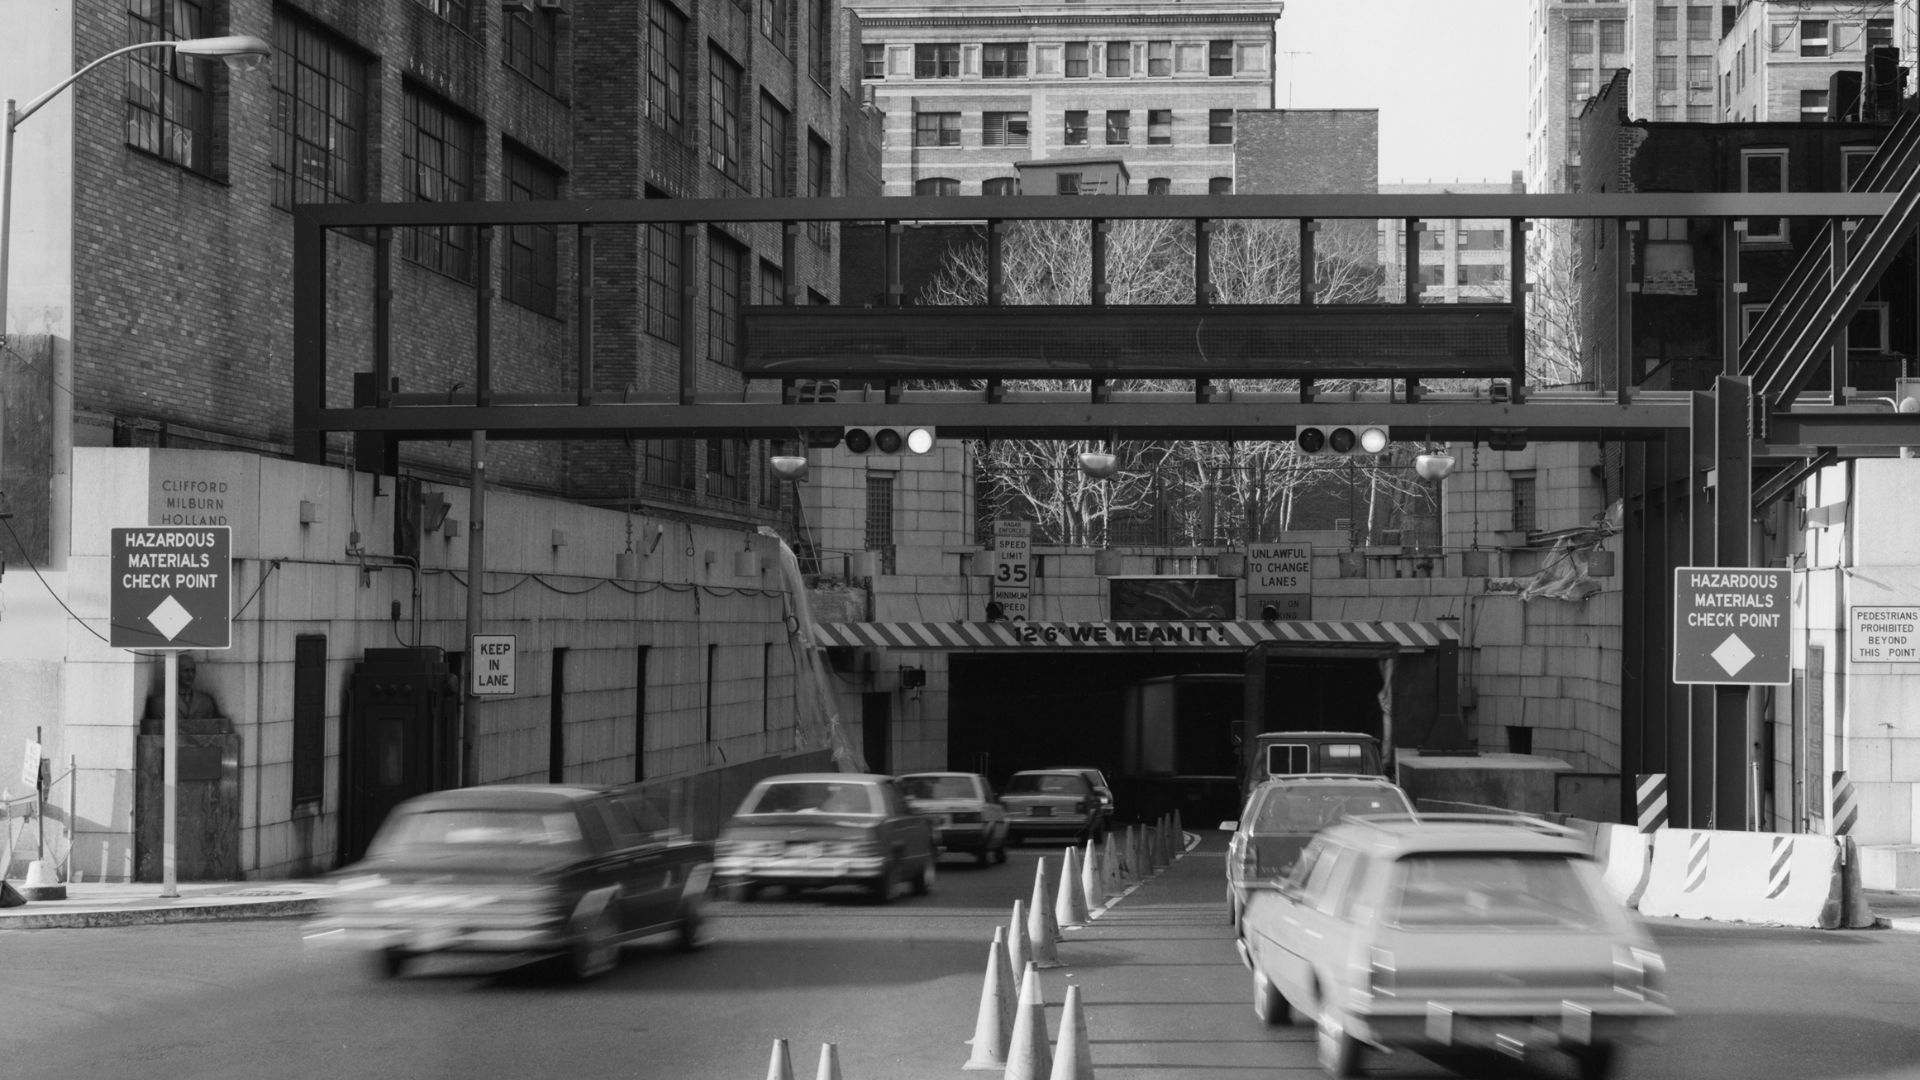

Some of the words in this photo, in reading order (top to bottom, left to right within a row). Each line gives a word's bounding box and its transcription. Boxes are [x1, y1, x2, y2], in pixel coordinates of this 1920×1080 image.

[162, 480, 228, 493] CLIFFORD
[167, 498, 224, 509] MILBURN
[162, 514, 227, 526] HOLLAND
[125, 533, 215, 547] HAZARDOUS
[1252, 549, 1307, 559] UNLAWFUL
[128, 554, 210, 568] MATERIALS
[1250, 563, 1262, 572] TO
[1267, 562, 1309, 572] CHANGE
[998, 564, 1027, 582] 35
[122, 574, 170, 588] CHECK
[176, 574, 218, 588] POINT
[1261, 576, 1297, 587] LANES
[1691, 574, 1778, 588] HAZARDOUS
[1695, 593, 1774, 608] MATERIALS
[1688, 613, 1735, 627] CHECK
[1739, 613, 1781, 628] POINT
[1857, 612, 1918, 620] PEDESTRIANS
[1069, 626, 1107, 642] WE
[1115, 626, 1183, 642] MEAN
[1861, 624, 1914, 632] PROHIBITED
[1868, 636, 1907, 645] BEYOND
[480, 643, 511, 655] KEEP
[1859, 648, 1880, 657] THIS
[1889, 648, 1916, 657] POINT
[489, 659, 500, 670] IN
[479, 674, 509, 686] LANE
